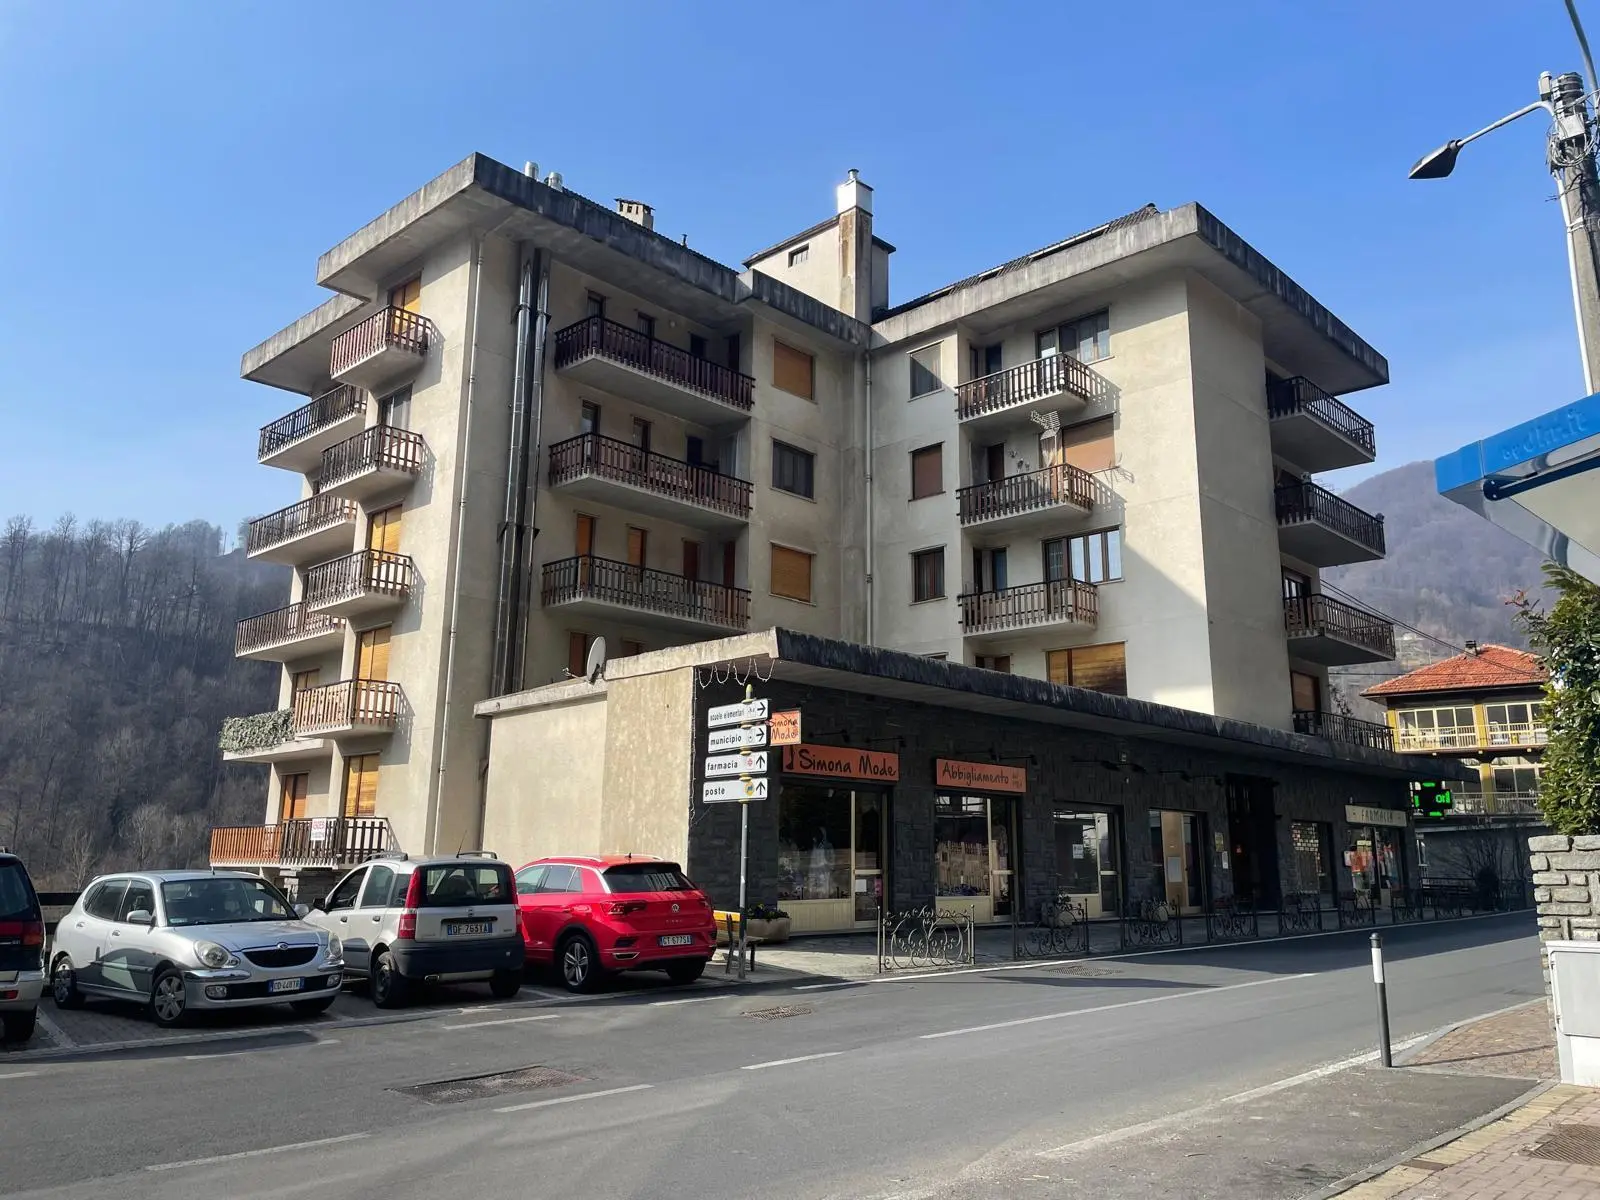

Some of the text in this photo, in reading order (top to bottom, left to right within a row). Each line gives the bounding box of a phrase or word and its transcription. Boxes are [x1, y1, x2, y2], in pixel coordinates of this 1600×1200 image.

[769, 716, 798, 728] Simona
[711, 734, 742, 746] municipio
[707, 760, 738, 771] farmacia
[798, 748, 897, 777] Simona Mode
[942, 762, 1009, 787] Abbigliamento
[705, 787, 725, 797] poste
